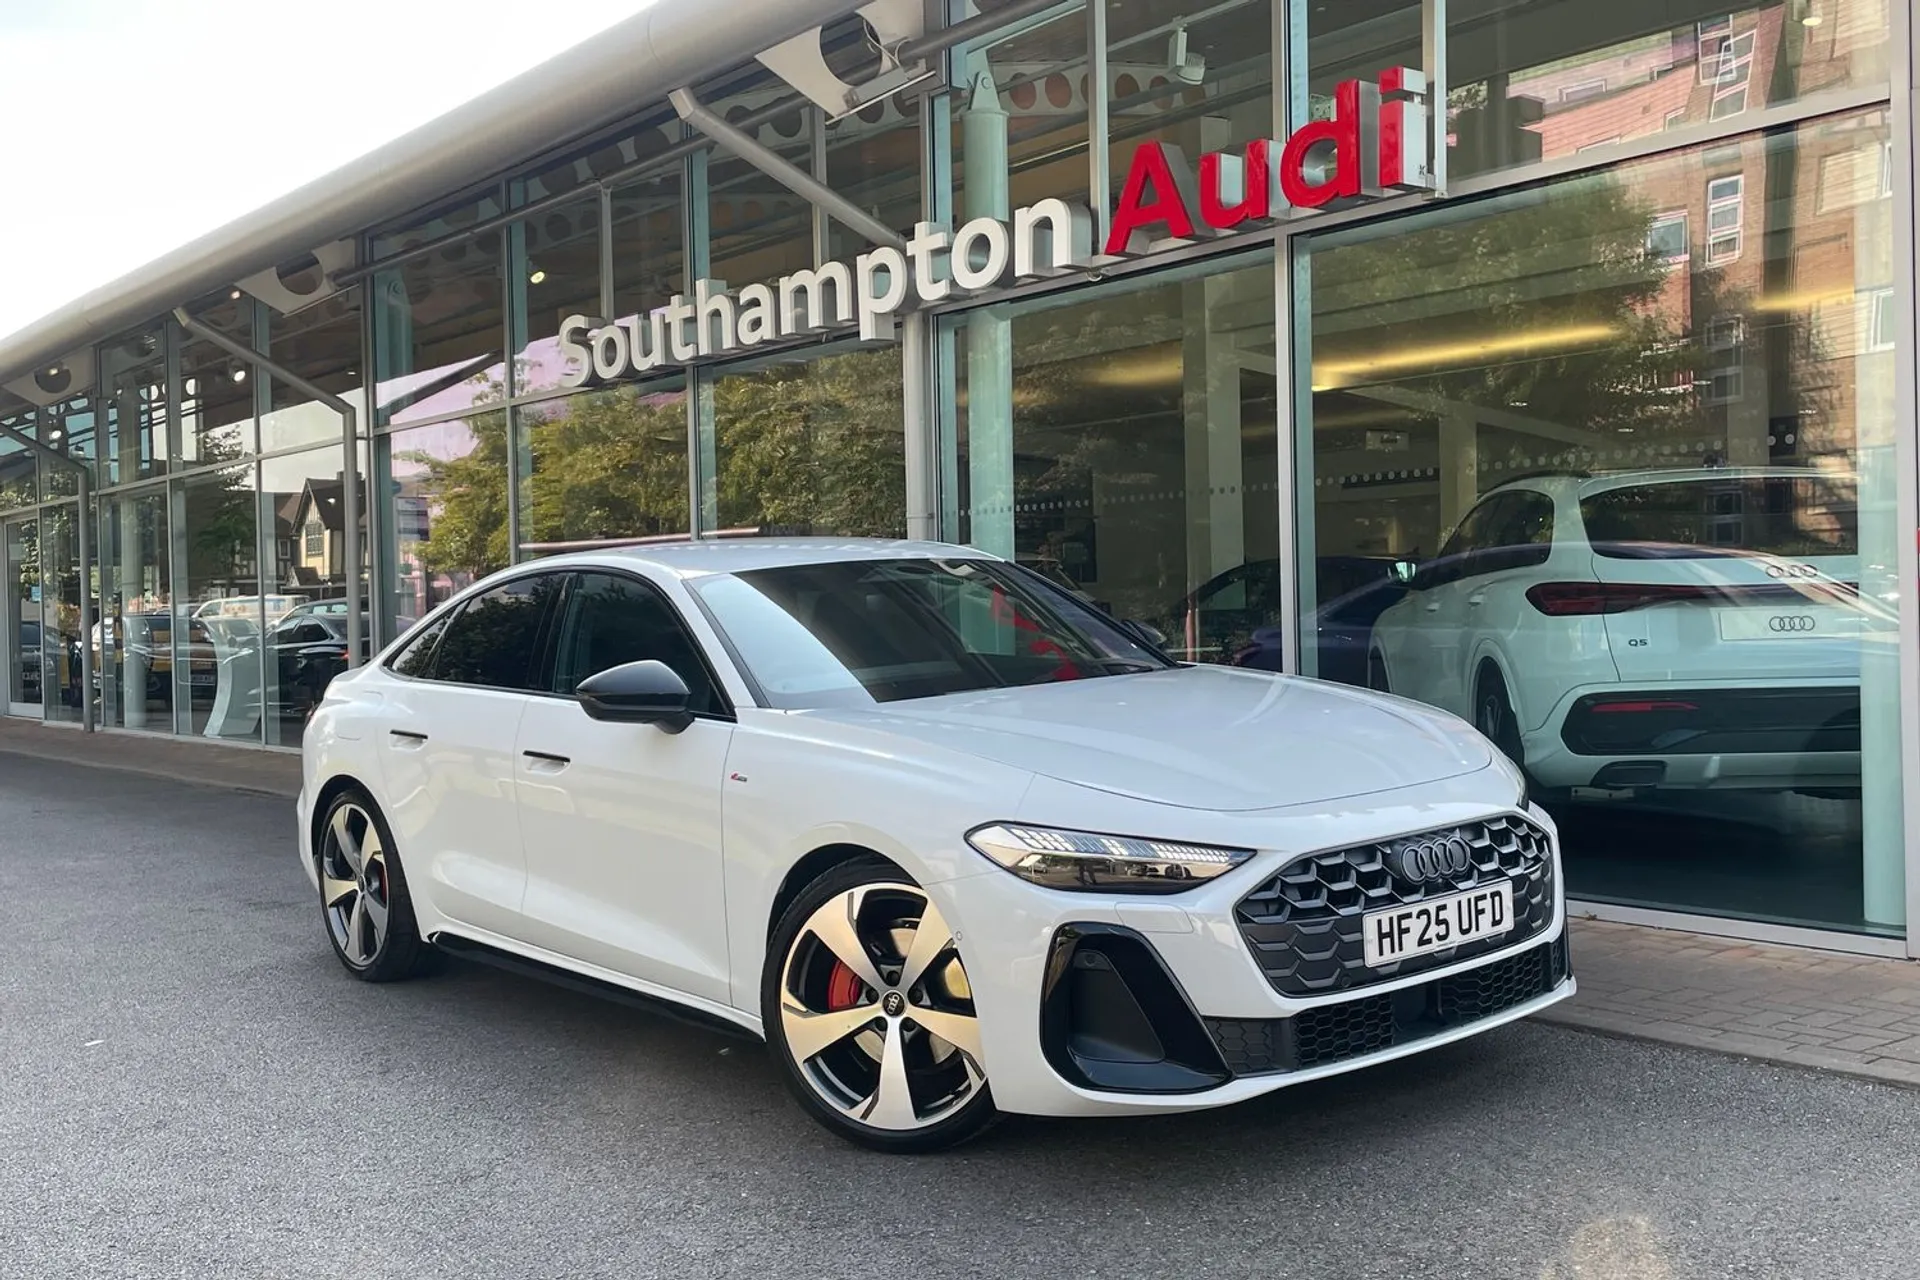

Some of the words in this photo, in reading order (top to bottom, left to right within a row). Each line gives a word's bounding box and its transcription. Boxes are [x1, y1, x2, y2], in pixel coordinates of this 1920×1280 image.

[559, 198, 1073, 387] Southampton
[1104, 65, 1406, 255] Audi
[1628, 638, 1648, 647] Q5
[1376, 903, 1450, 957] HF25
[1457, 890, 1504, 936] UFD
